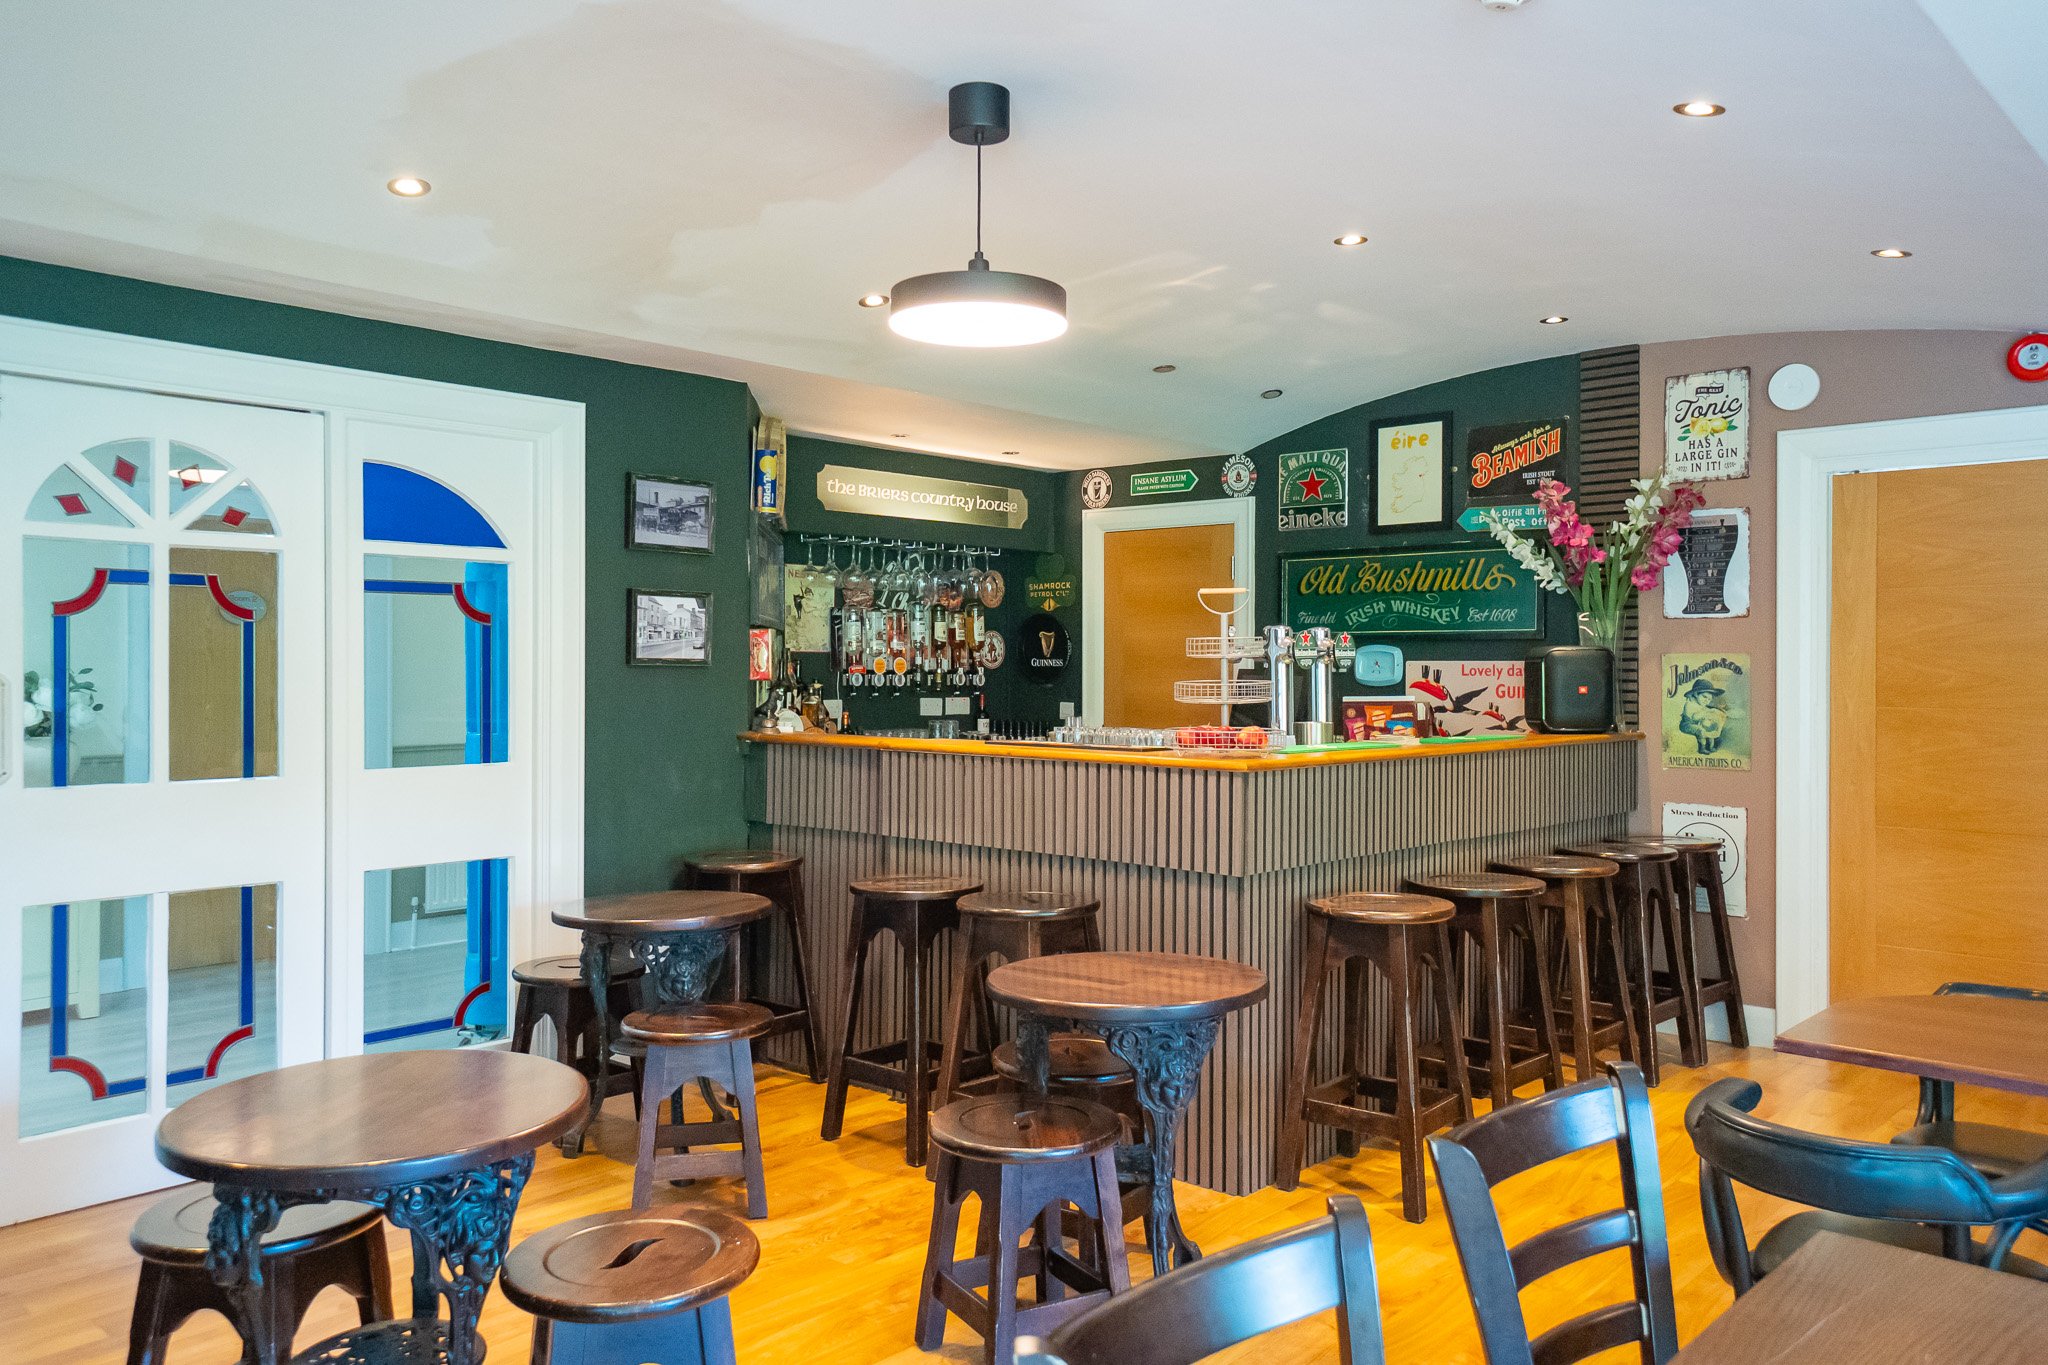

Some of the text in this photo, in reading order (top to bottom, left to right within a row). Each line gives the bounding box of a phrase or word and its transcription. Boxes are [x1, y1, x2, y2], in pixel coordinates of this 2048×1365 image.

[1675, 394, 1743, 423] Tonic
[1391, 430, 1430, 450] éire
[1492, 438, 1518, 454] Always
[1520, 431, 1532, 442] ask
[1532, 428, 1544, 438] for
[1688, 438, 1724, 450] HAS A
[1288, 452, 1318, 470] MALT
[1472, 428, 1560, 488] BEAMISH
[1675, 448, 1738, 463] LARGE GIN
[1222, 454, 1256, 474] JAMESON
[1691, 461, 1721, 473] IN IT!
[1134, 474, 1187, 486] INSANE ASYLUM
[1538, 470, 1556, 478] STOUT
[763, 482, 772, 504] Rich
[826, 478, 856, 496] the
[976, 496, 1018, 513] house
[1234, 480, 1256, 498] WHISKEY
[1524, 508, 1534, 516] an
[1502, 518, 1526, 527] Post
[1531, 518, 1548, 526] Off
[1300, 557, 1516, 595] Old Bushmills
[1028, 582, 1071, 590] SHAMROCK
[1030, 590, 1054, 598] PETROL
[1345, 598, 1460, 627] IRISH WHISKEY
[1467, 606, 1518, 622] Est 1608
[1031, 658, 1064, 667] GUINNESS
[1461, 664, 1524, 680] Lovely da
[1496, 684, 1525, 699] GUI
[1669, 756, 1742, 768] AMERICAN FRUITS CO
[1670, 808, 1739, 820] Stress Reduction
